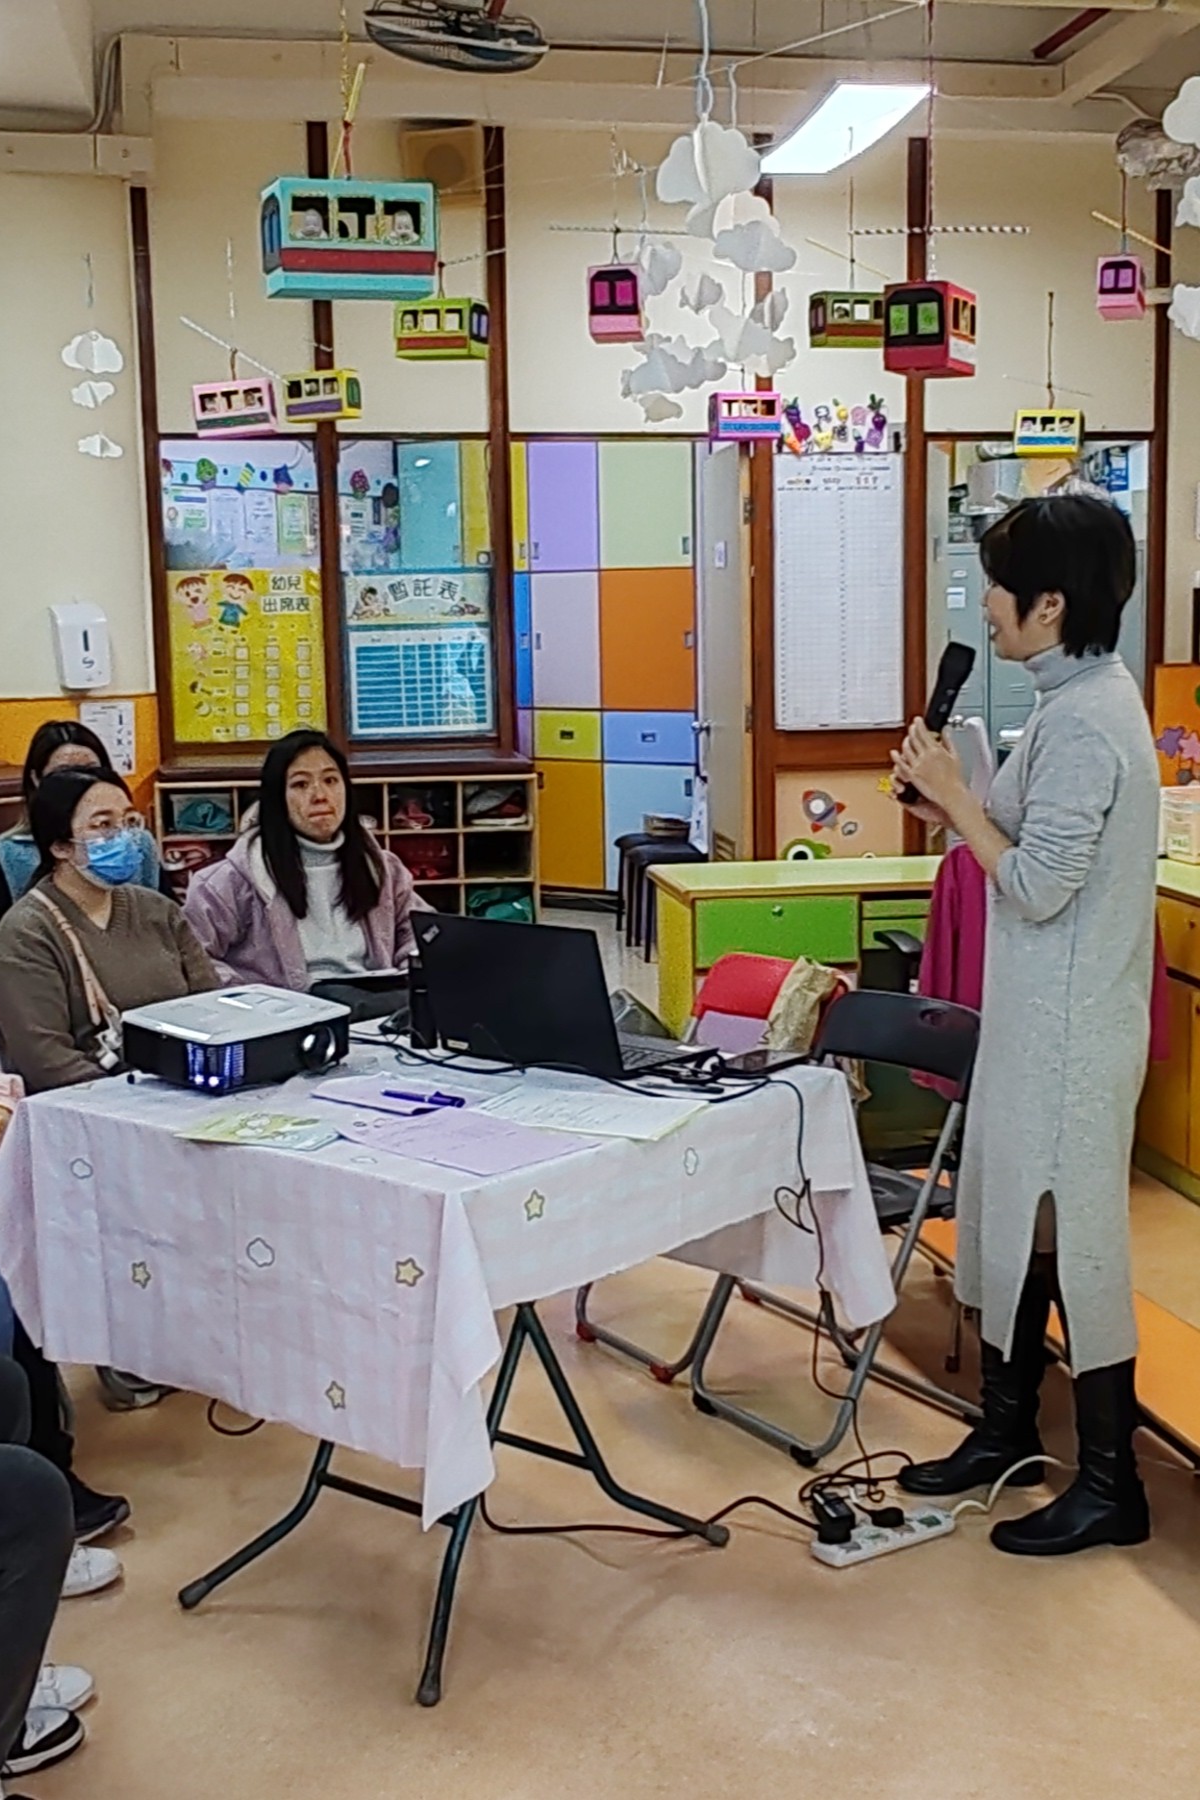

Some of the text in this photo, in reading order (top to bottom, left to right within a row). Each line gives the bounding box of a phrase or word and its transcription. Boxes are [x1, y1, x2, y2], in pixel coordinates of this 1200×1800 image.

[271, 575, 302, 592] 幼兒
[262, 596, 310, 613] 出席表
